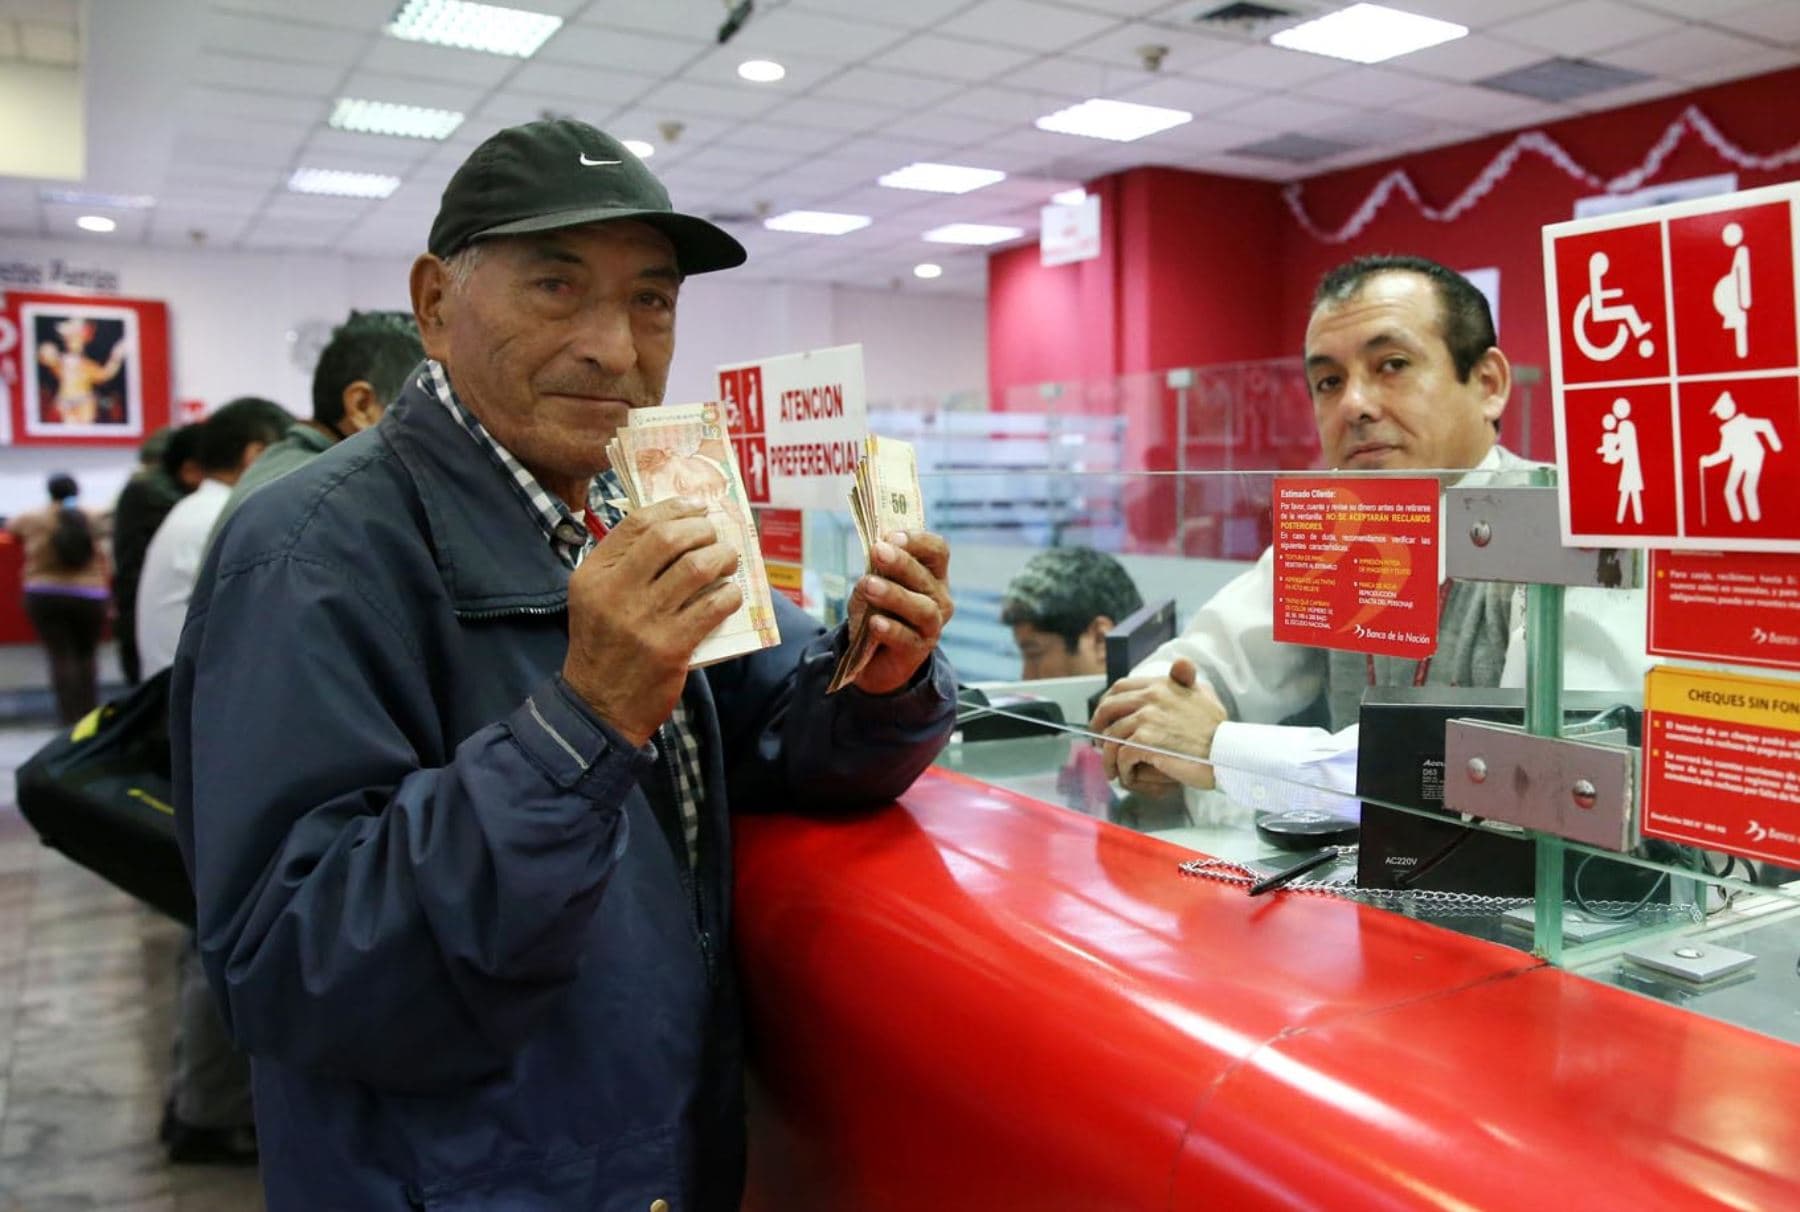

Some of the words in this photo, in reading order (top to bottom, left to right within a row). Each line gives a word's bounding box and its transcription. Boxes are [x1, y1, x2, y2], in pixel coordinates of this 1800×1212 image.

[779, 384, 844, 423] ATENCION
[770, 441, 860, 477] PREFERENCIAL
[891, 492, 907, 515] 50
[1281, 489, 1310, 498] Estimado
[1366, 628, 1386, 639] Banco
[1388, 631, 1396, 640] de
[1397, 632, 1404, 641] la
[1405, 632, 1431, 644] Nación
[1688, 688, 1745, 707] CHEQUES
[1748, 696, 1769, 710] SIN
[1385, 857, 1418, 867] AC220V
